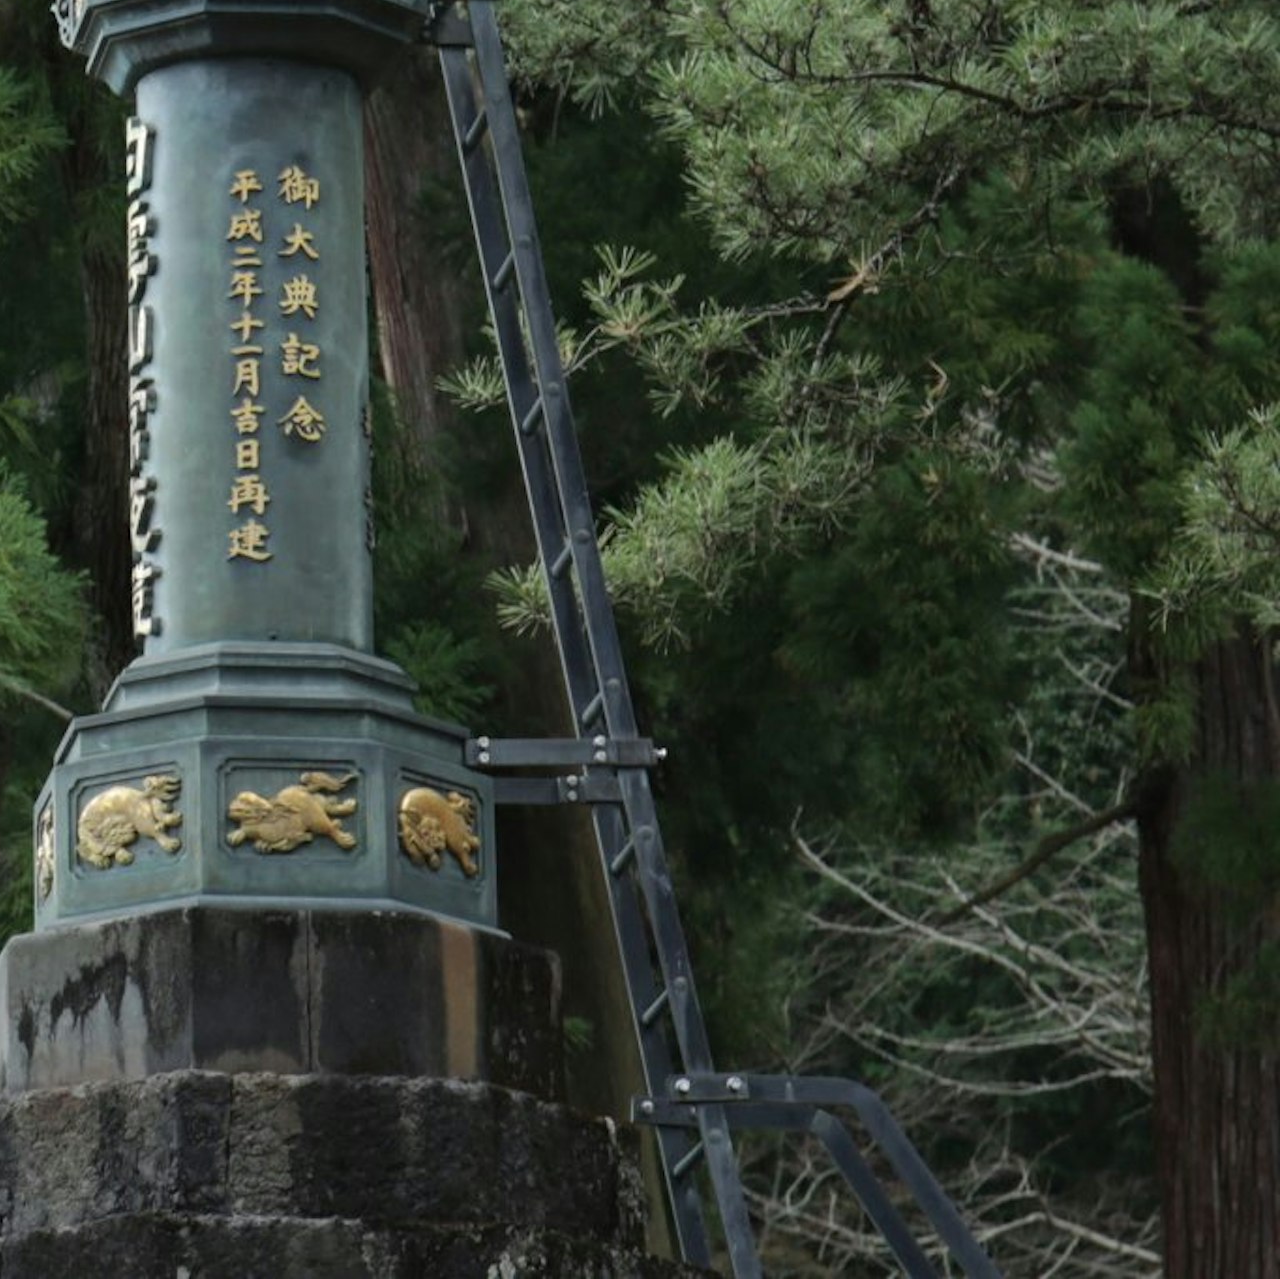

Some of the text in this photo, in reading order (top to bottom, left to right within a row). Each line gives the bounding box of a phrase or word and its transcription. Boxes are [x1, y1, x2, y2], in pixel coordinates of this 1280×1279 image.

[226, 168, 273, 562] 平成二年十一月吉日再建
[278, 165, 326, 442] 御大典記念
